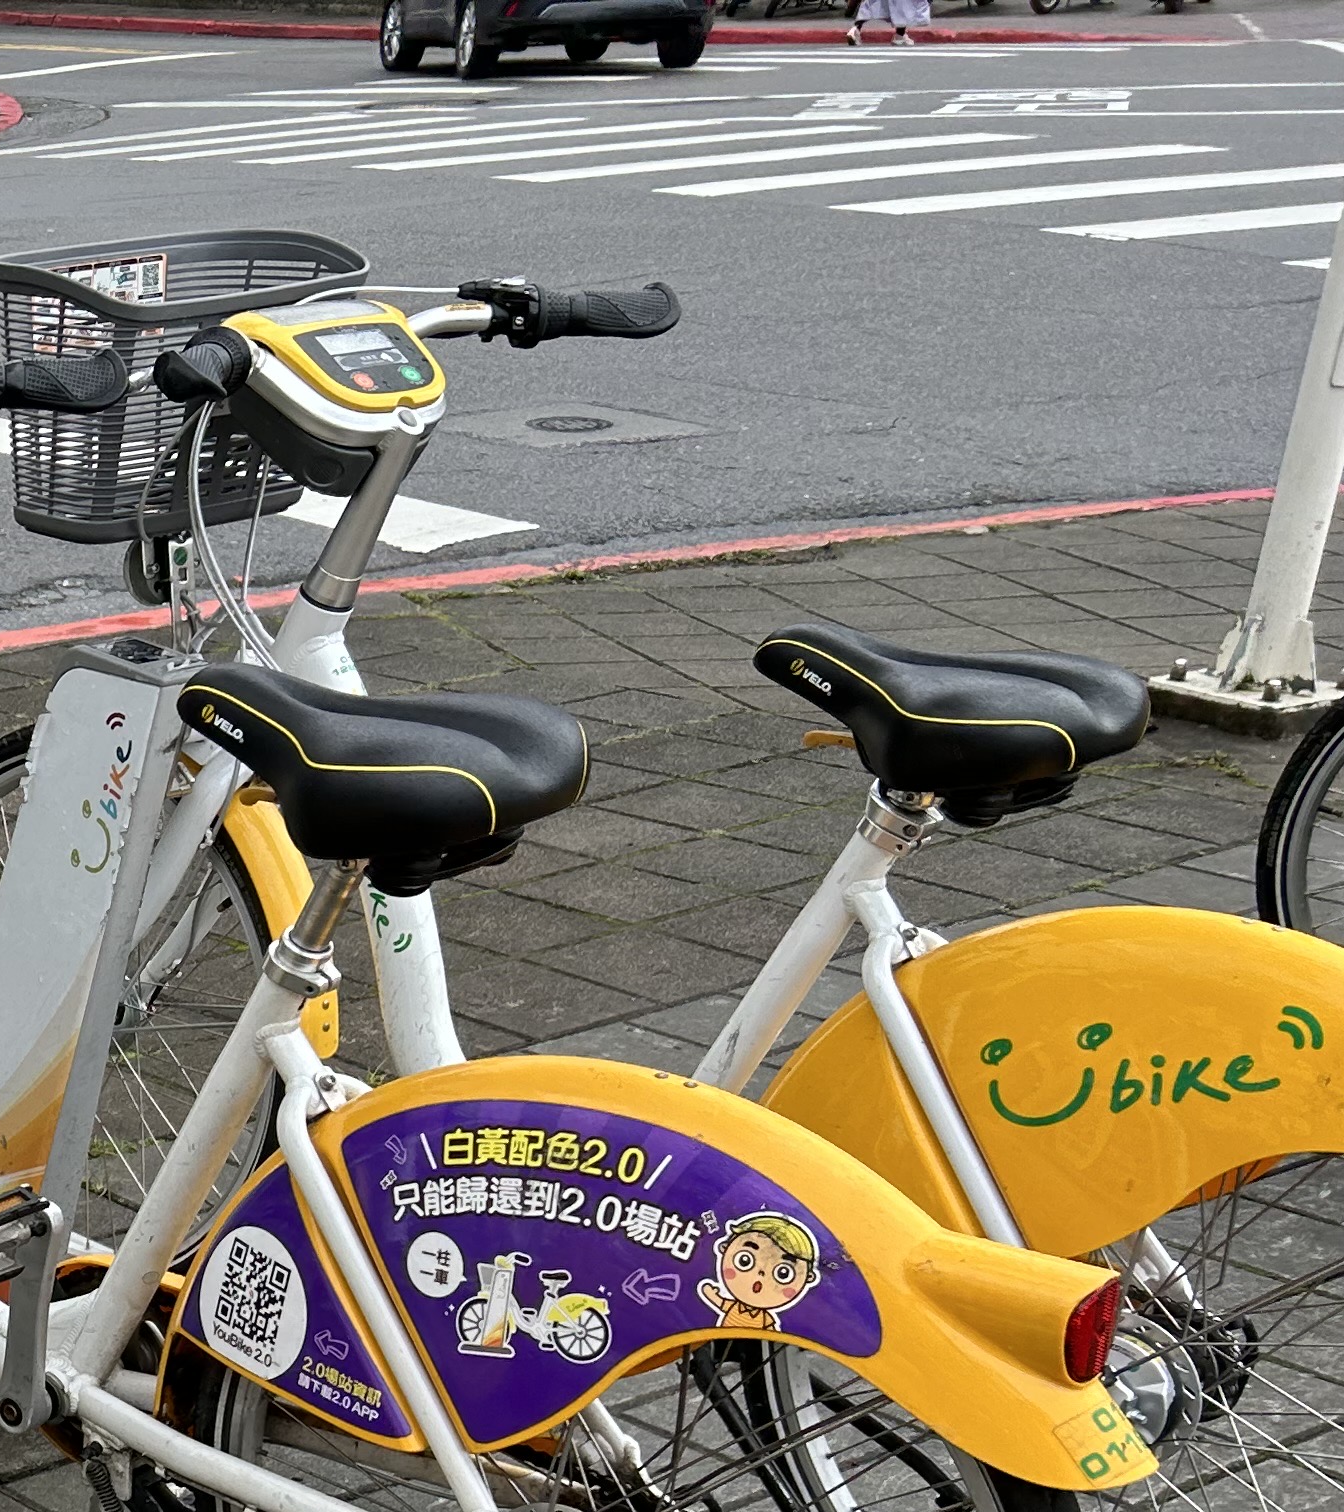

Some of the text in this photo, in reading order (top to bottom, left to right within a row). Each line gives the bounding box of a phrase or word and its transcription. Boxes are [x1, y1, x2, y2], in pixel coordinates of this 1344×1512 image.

[802, 667, 832, 695] VELO
[213, 713, 244, 741] VELO
[442, 1127, 646, 1185] 白黃配色2.0
[392, 1175, 702, 1261] 只能歸還到2.0場站
[419, 1267, 449, 1286] 一車
[212, 1322, 274, 1369] YouBike 2.0
[350, 1401, 380, 1423] APP
